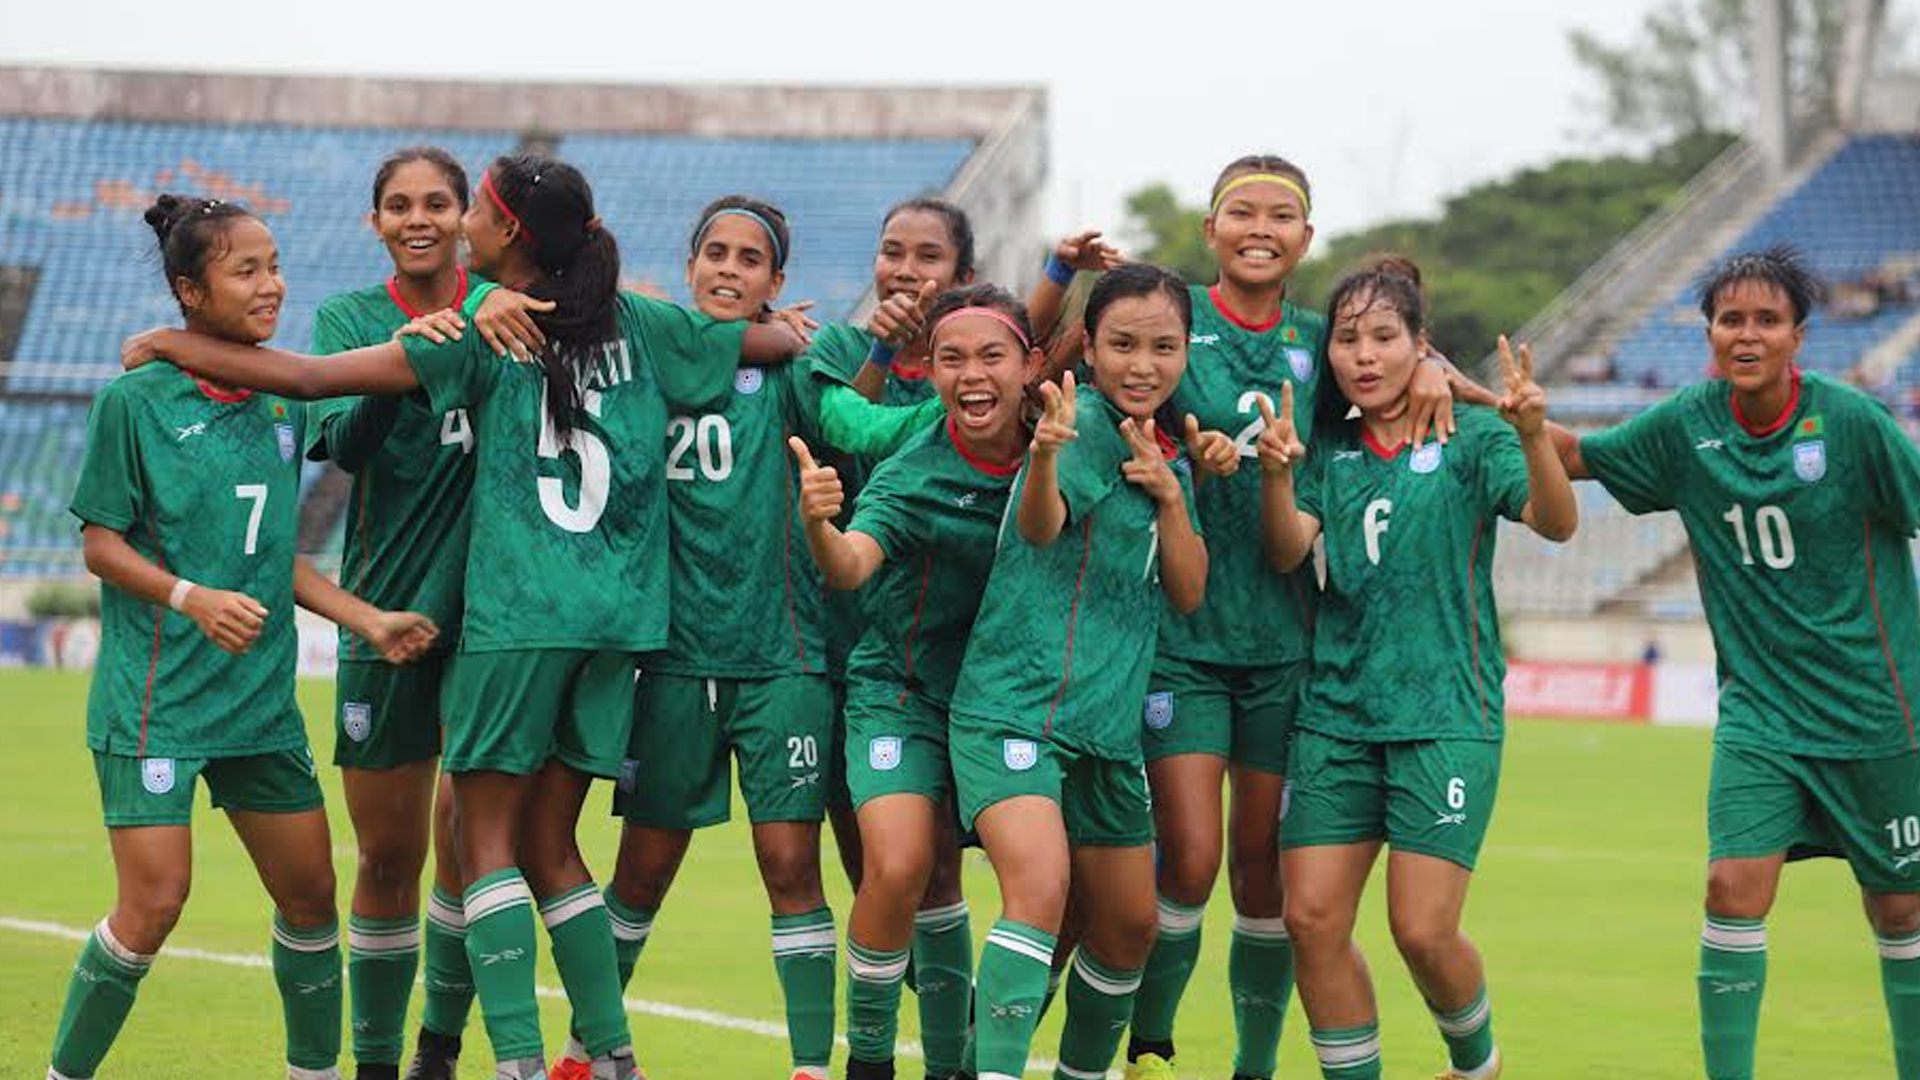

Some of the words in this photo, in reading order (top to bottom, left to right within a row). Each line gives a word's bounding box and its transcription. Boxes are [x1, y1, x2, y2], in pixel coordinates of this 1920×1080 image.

[441, 408, 474, 455] 4
[537, 374, 611, 533] 5
[666, 414, 732, 481] 20
[235, 484, 267, 554] 7
[1723, 503, 1795, 569] 10
[787, 735, 818, 768] 20
[1447, 778, 1465, 809] 6
[1885, 815, 1920, 848] 10
